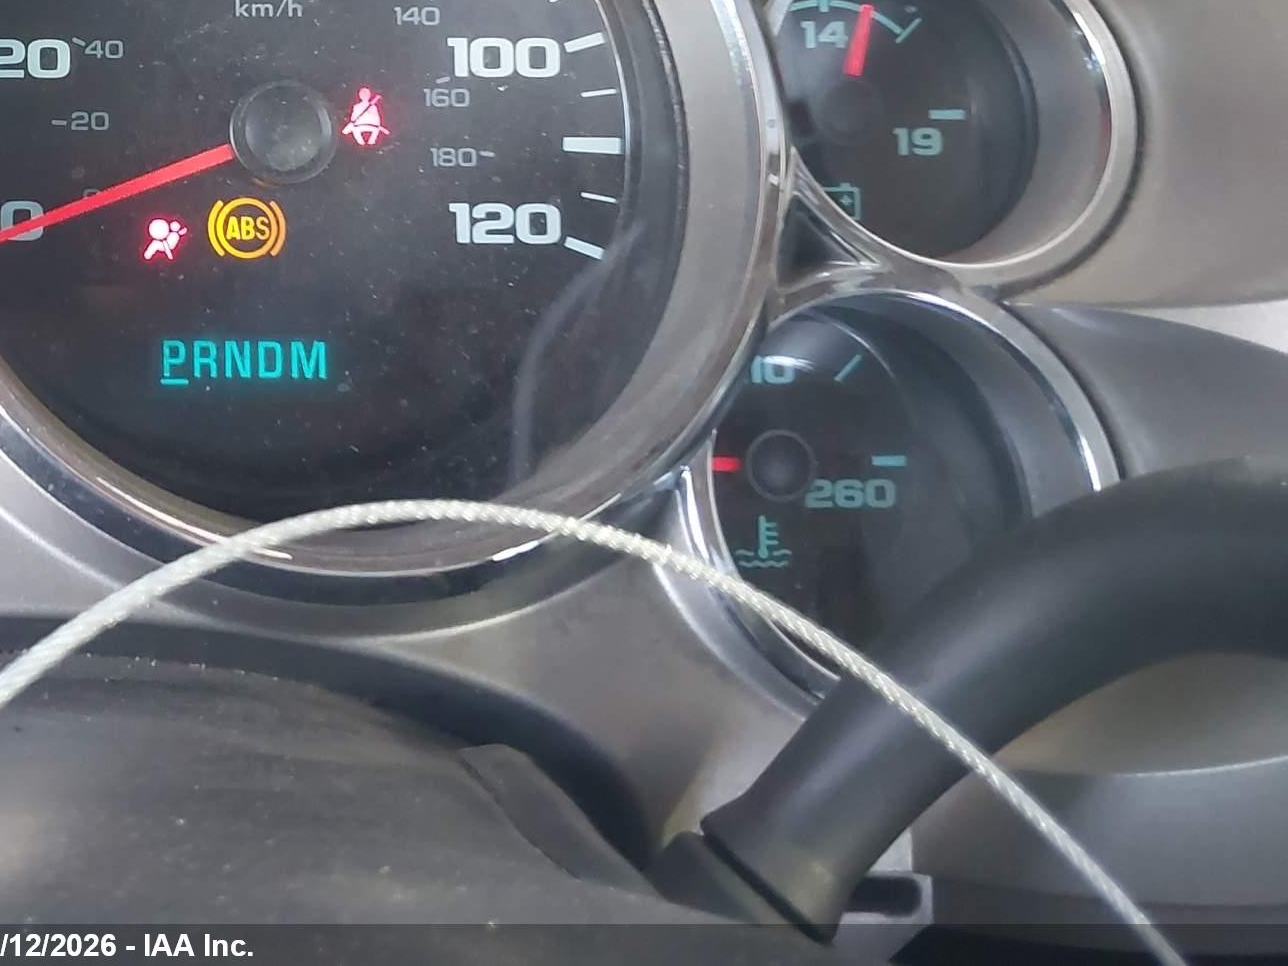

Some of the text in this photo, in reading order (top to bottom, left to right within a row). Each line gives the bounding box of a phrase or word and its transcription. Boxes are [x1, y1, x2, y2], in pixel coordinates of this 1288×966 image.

[234, 0, 303, 19] km/h
[394, 7, 440, 26] 140
[801, 20, 849, 49] 14
[85, 40, 124, 59] 40
[447, 37, 560, 78] 100
[423, 89, 470, 107] 160
[71, 113, 109, 131] 20
[893, 127, 944, 156] 19
[430, 148, 477, 167] 180
[0, 200, 45, 241] 0
[226, 215, 271, 240] ABS
[449, 203, 561, 244] 120
[161, 339, 328, 384] PRNDM
[750, 355, 795, 384] 10
[805, 478, 896, 508] 260
